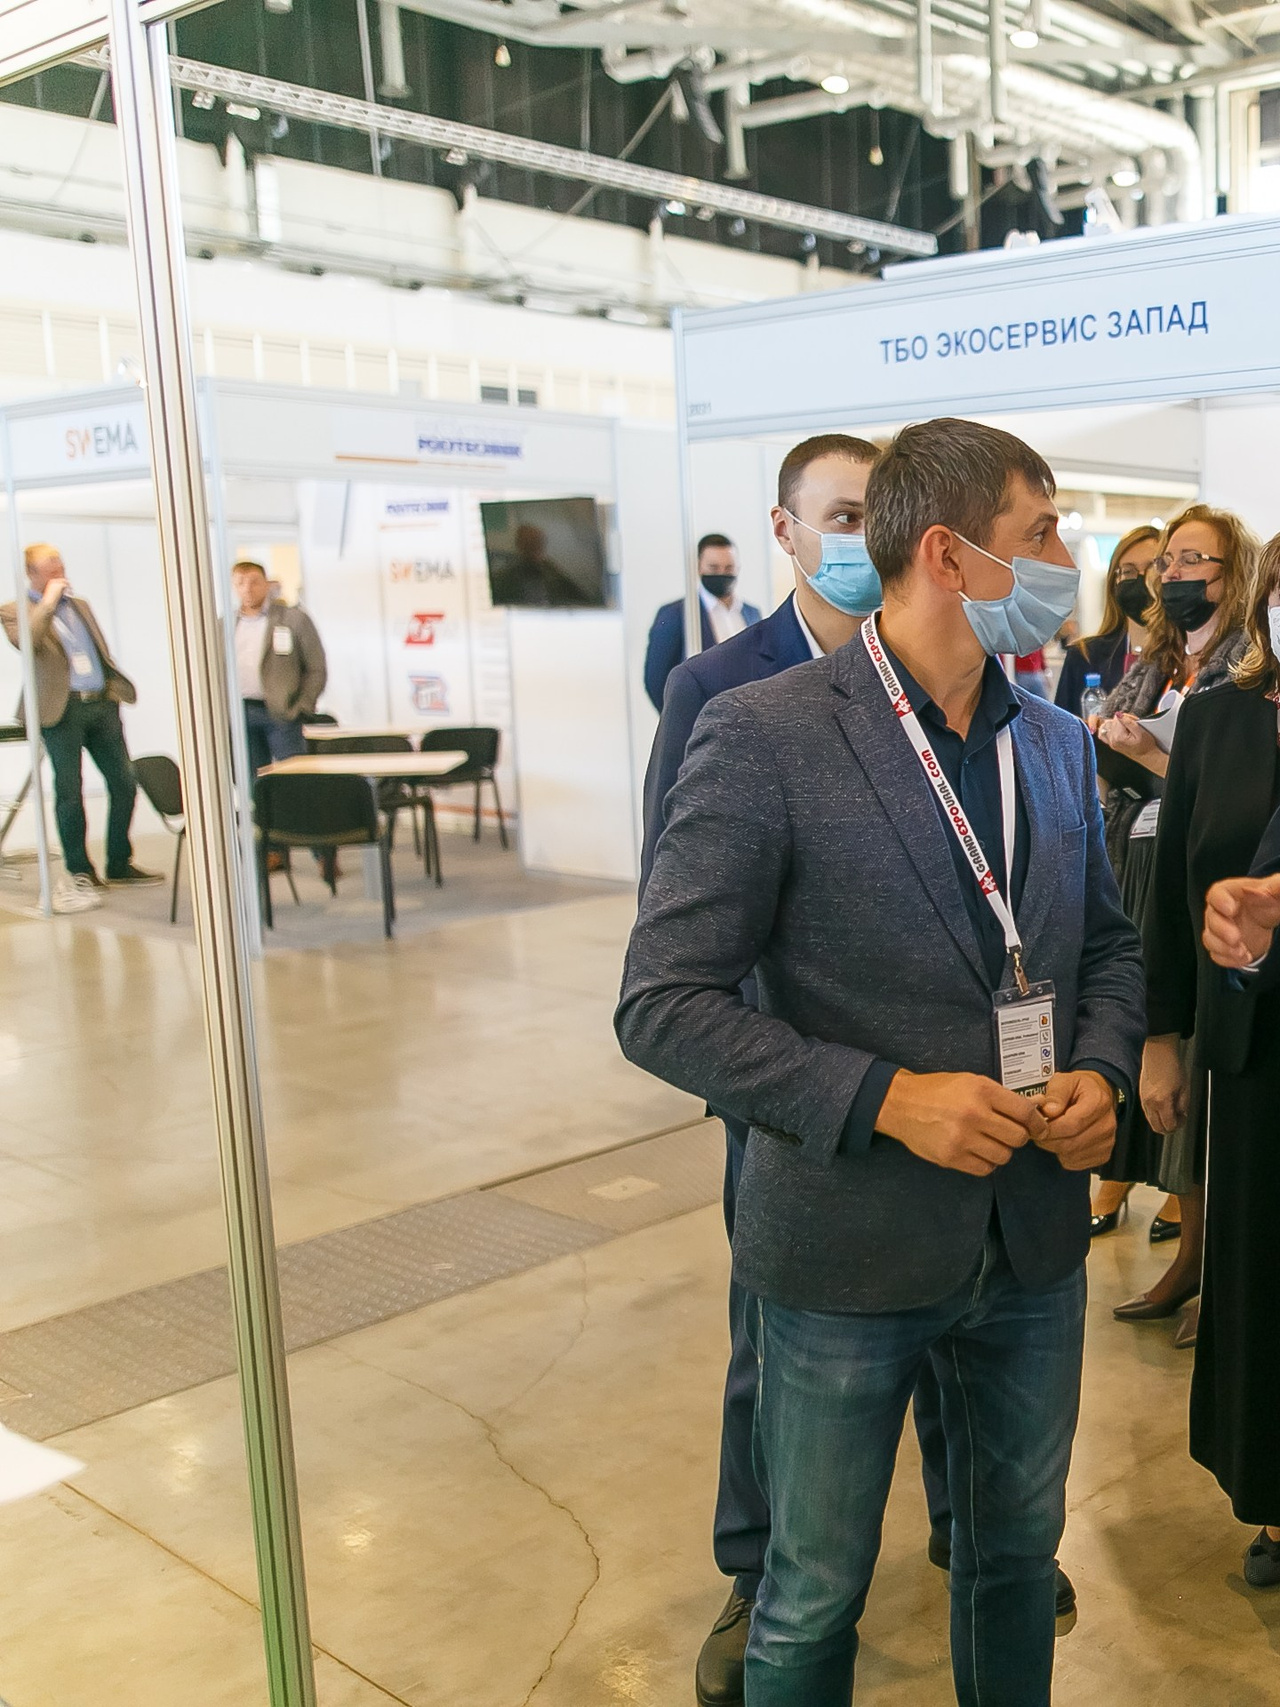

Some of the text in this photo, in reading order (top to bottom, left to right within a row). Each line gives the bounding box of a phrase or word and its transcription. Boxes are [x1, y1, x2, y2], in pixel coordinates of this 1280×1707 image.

[879, 300, 1209, 365] ТБО ЭКОСЕРВИС ЗАПАД
